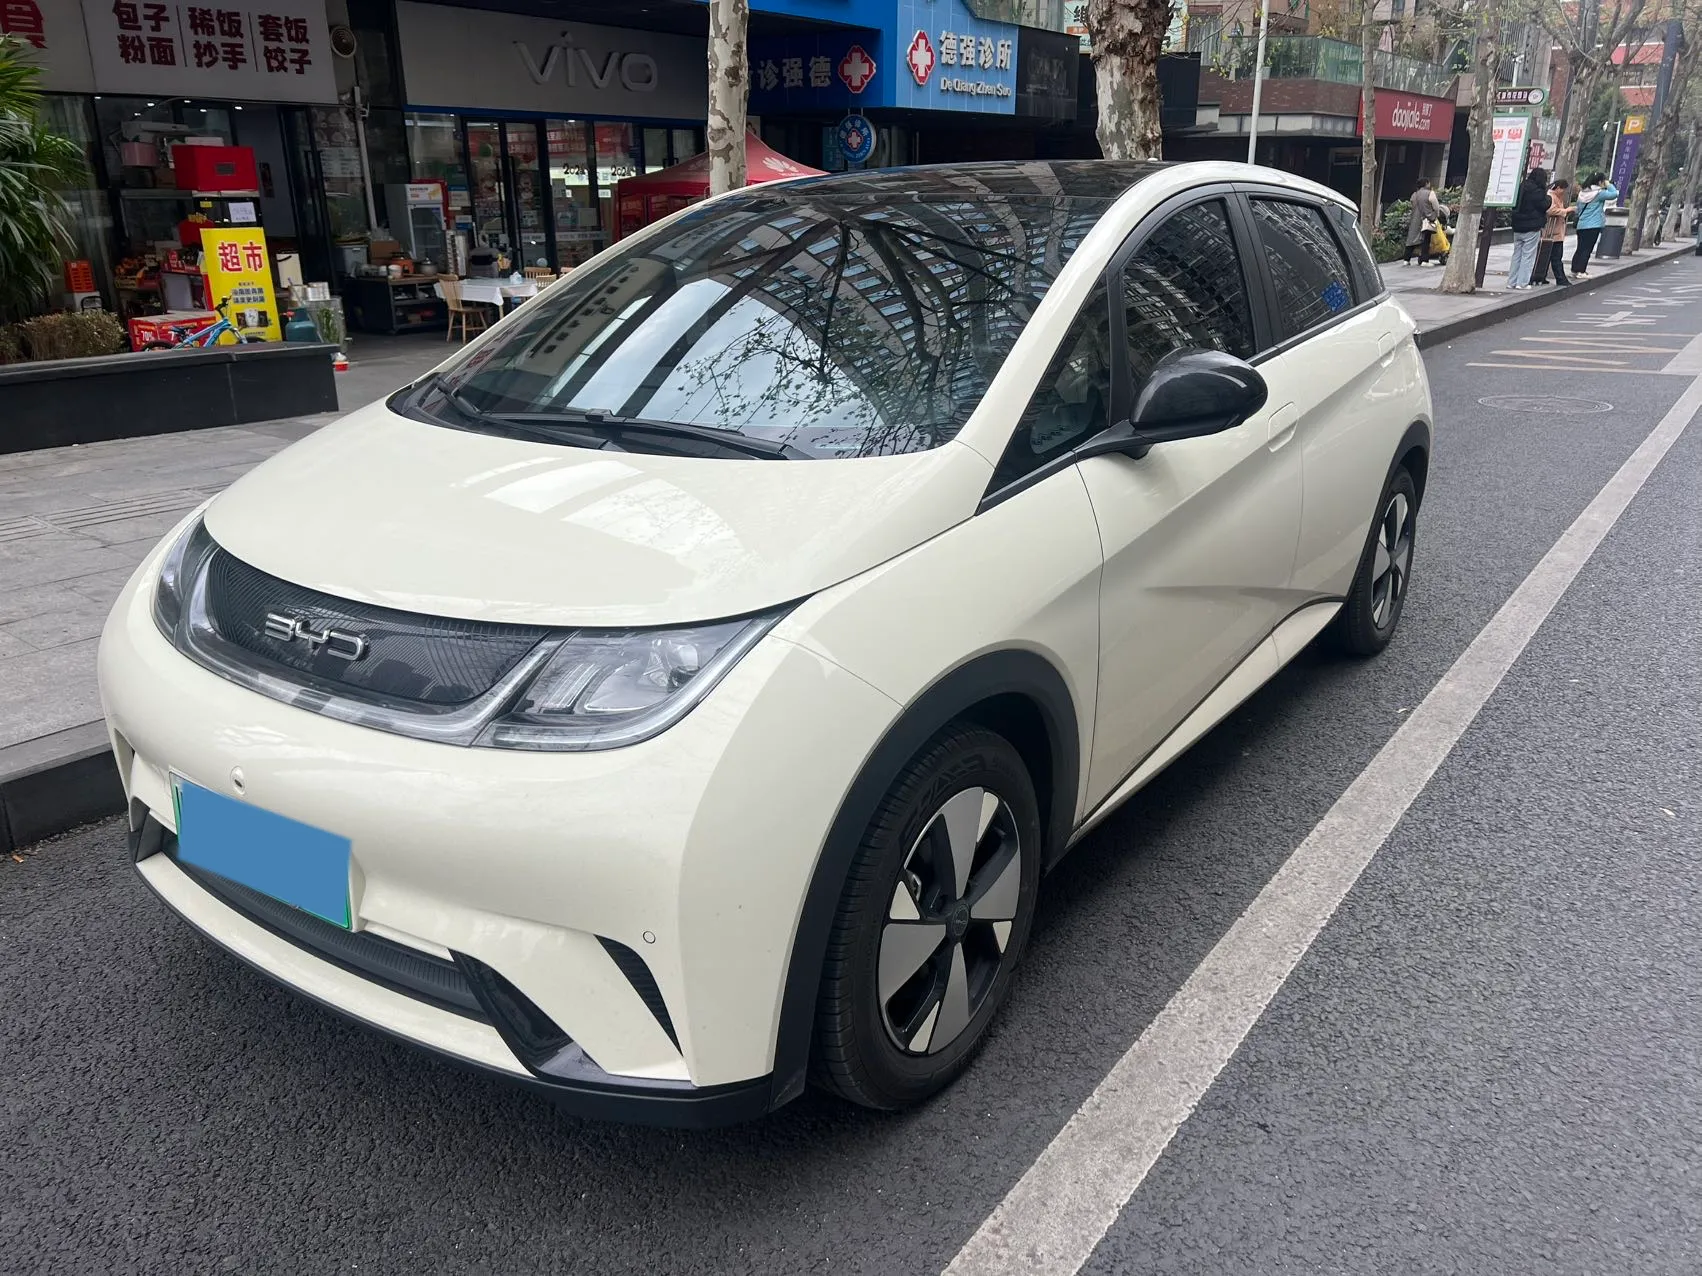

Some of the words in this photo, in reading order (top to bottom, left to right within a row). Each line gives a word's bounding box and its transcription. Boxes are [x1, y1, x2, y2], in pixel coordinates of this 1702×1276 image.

[112, 0, 170, 32] 包子
[187, 5, 244, 40] 稀饭
[258, 14, 311, 45] 套饭
[117, 34, 177, 67] 粉面
[194, 41, 248, 71] 抄手
[264, 46, 312, 75] 饺子
[512, 31, 659, 92] vivo
[940, 30, 1012, 70] 德强诊所
[940, 77, 953, 90] De
[953, 78, 976, 95] Qiang
[976, 81, 996, 95] Zhen
[996, 83, 1012, 97] Suo
[1627, 119, 1641, 131] P
[218, 241, 263, 273] 超市
[264, 612, 366, 661] BYD
